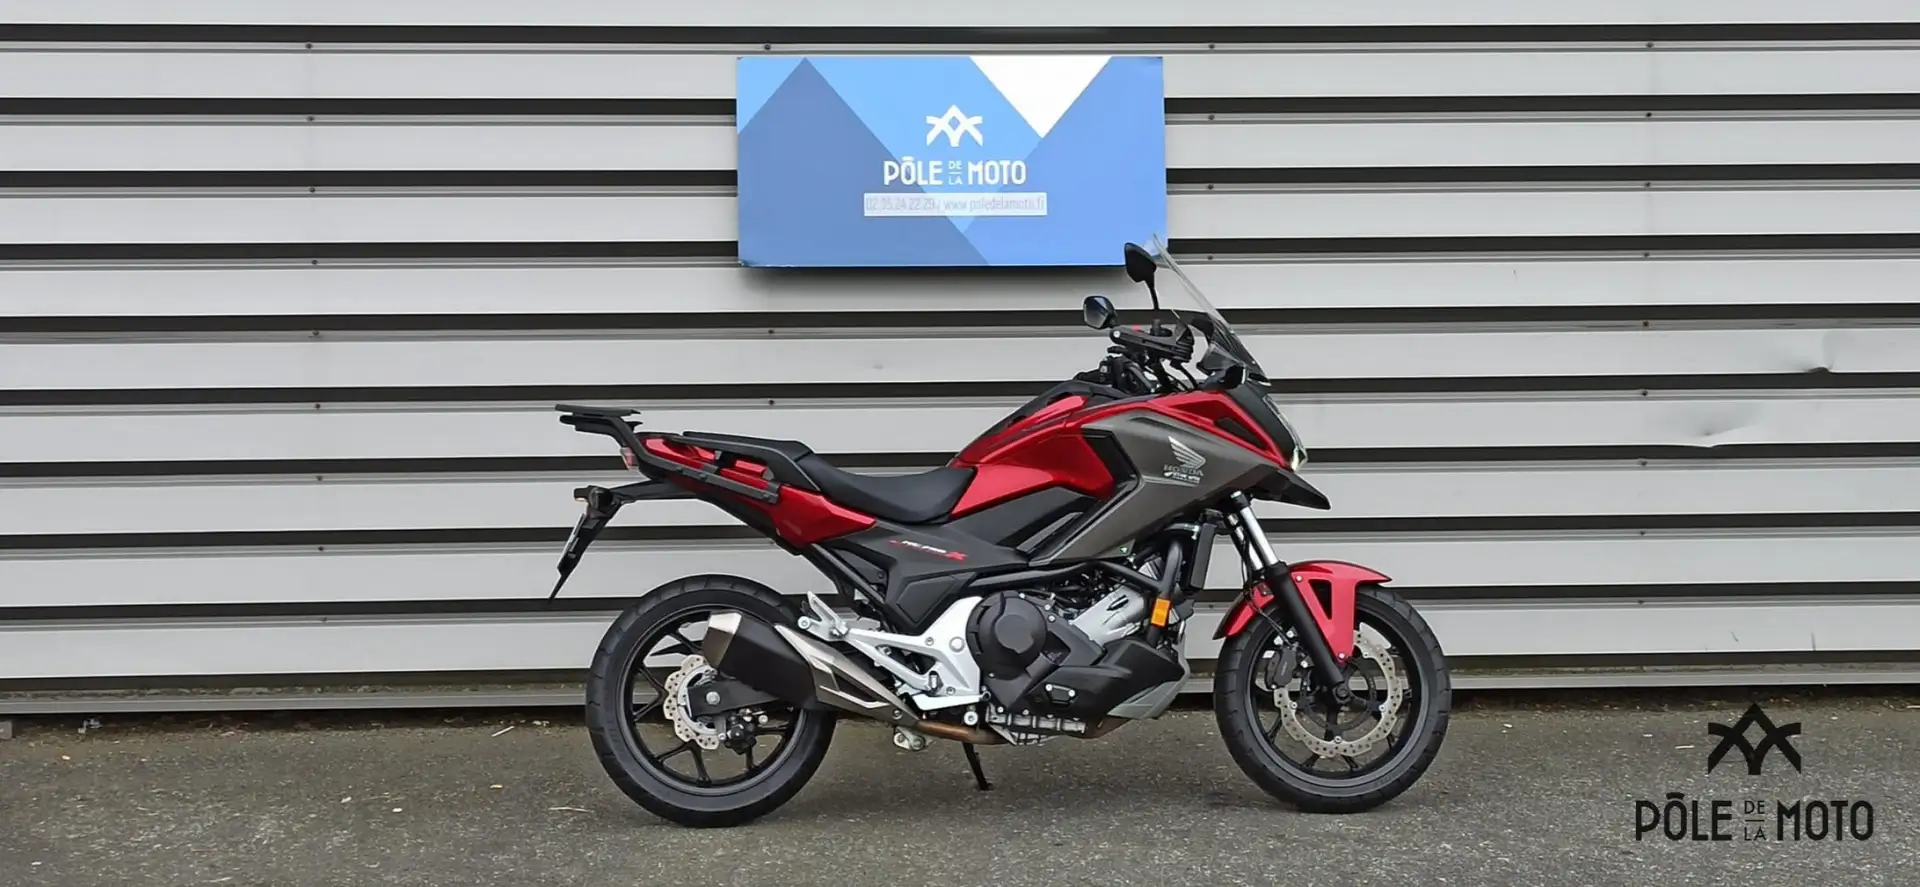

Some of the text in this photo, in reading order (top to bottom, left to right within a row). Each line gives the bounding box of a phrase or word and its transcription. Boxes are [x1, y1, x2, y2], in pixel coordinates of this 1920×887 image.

[883, 156, 943, 185] PÔLE
[948, 160, 962, 170] DE
[968, 160, 1027, 185] MOTO
[948, 177, 963, 185] LA
[1163, 464, 1204, 477] HONDA
